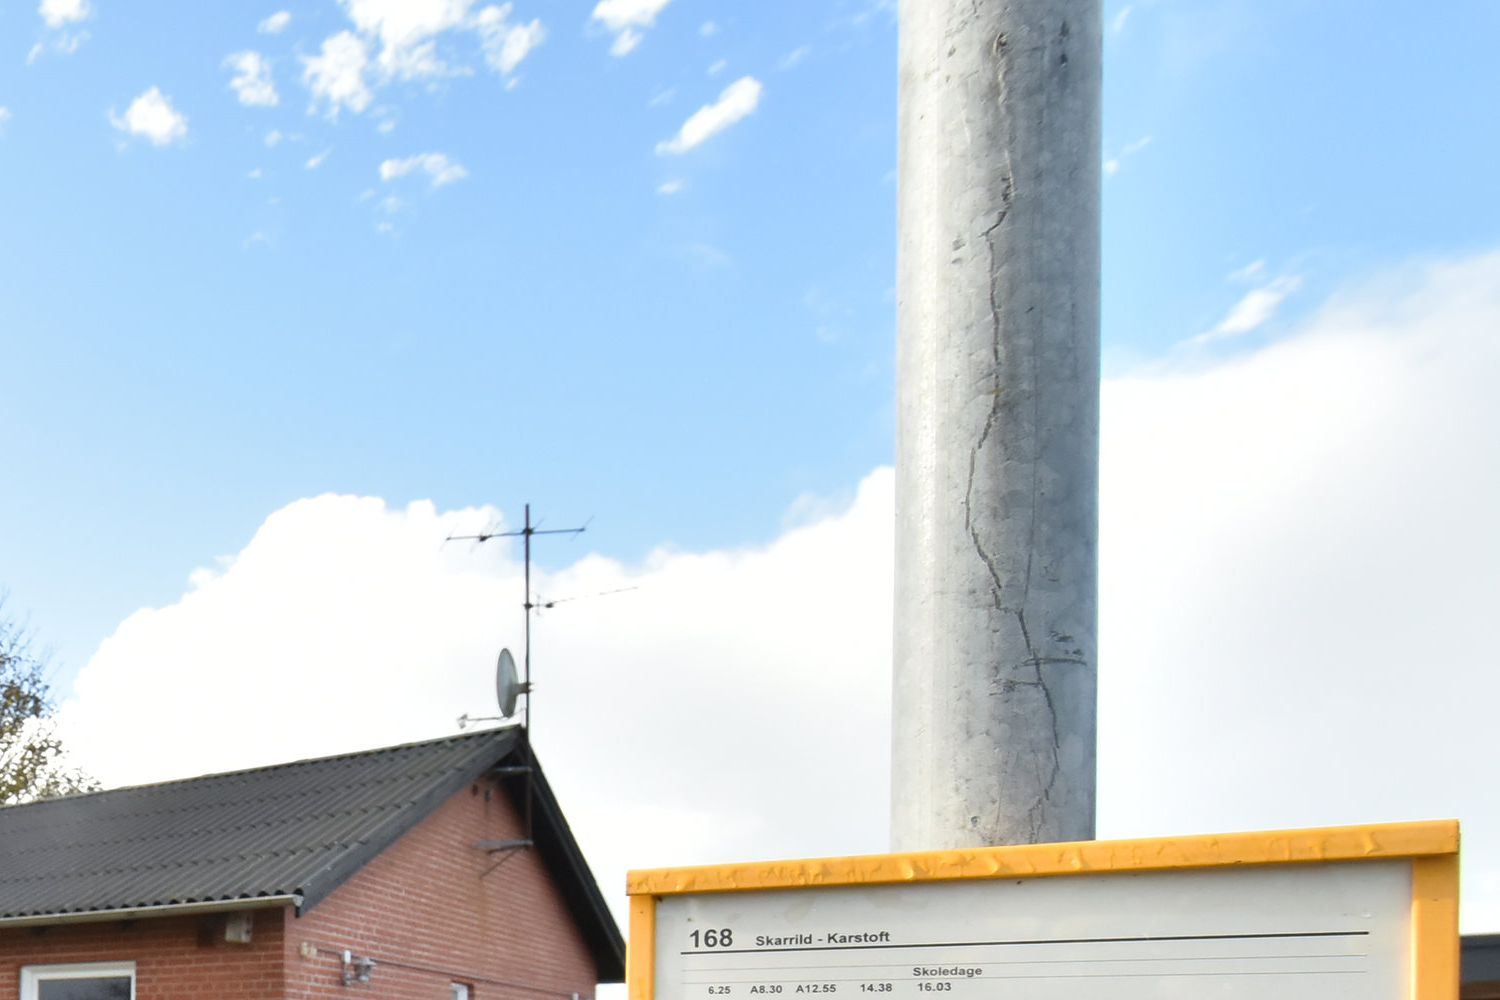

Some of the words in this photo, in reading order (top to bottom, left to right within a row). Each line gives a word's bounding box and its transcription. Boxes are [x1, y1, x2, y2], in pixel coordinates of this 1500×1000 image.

[689, 928, 733, 948] 168
[755, 933, 813, 947] Skarrild
[827, 931, 891, 945] Karstoft
[912, 966, 983, 978] Skoledage
[708, 986, 731, 995] 6.25
[750, 984, 783, 994] A8.30
[795, 984, 837, 994] A12.55
[860, 983, 893, 993] 14.38
[917, 982, 952, 992] 16.03
